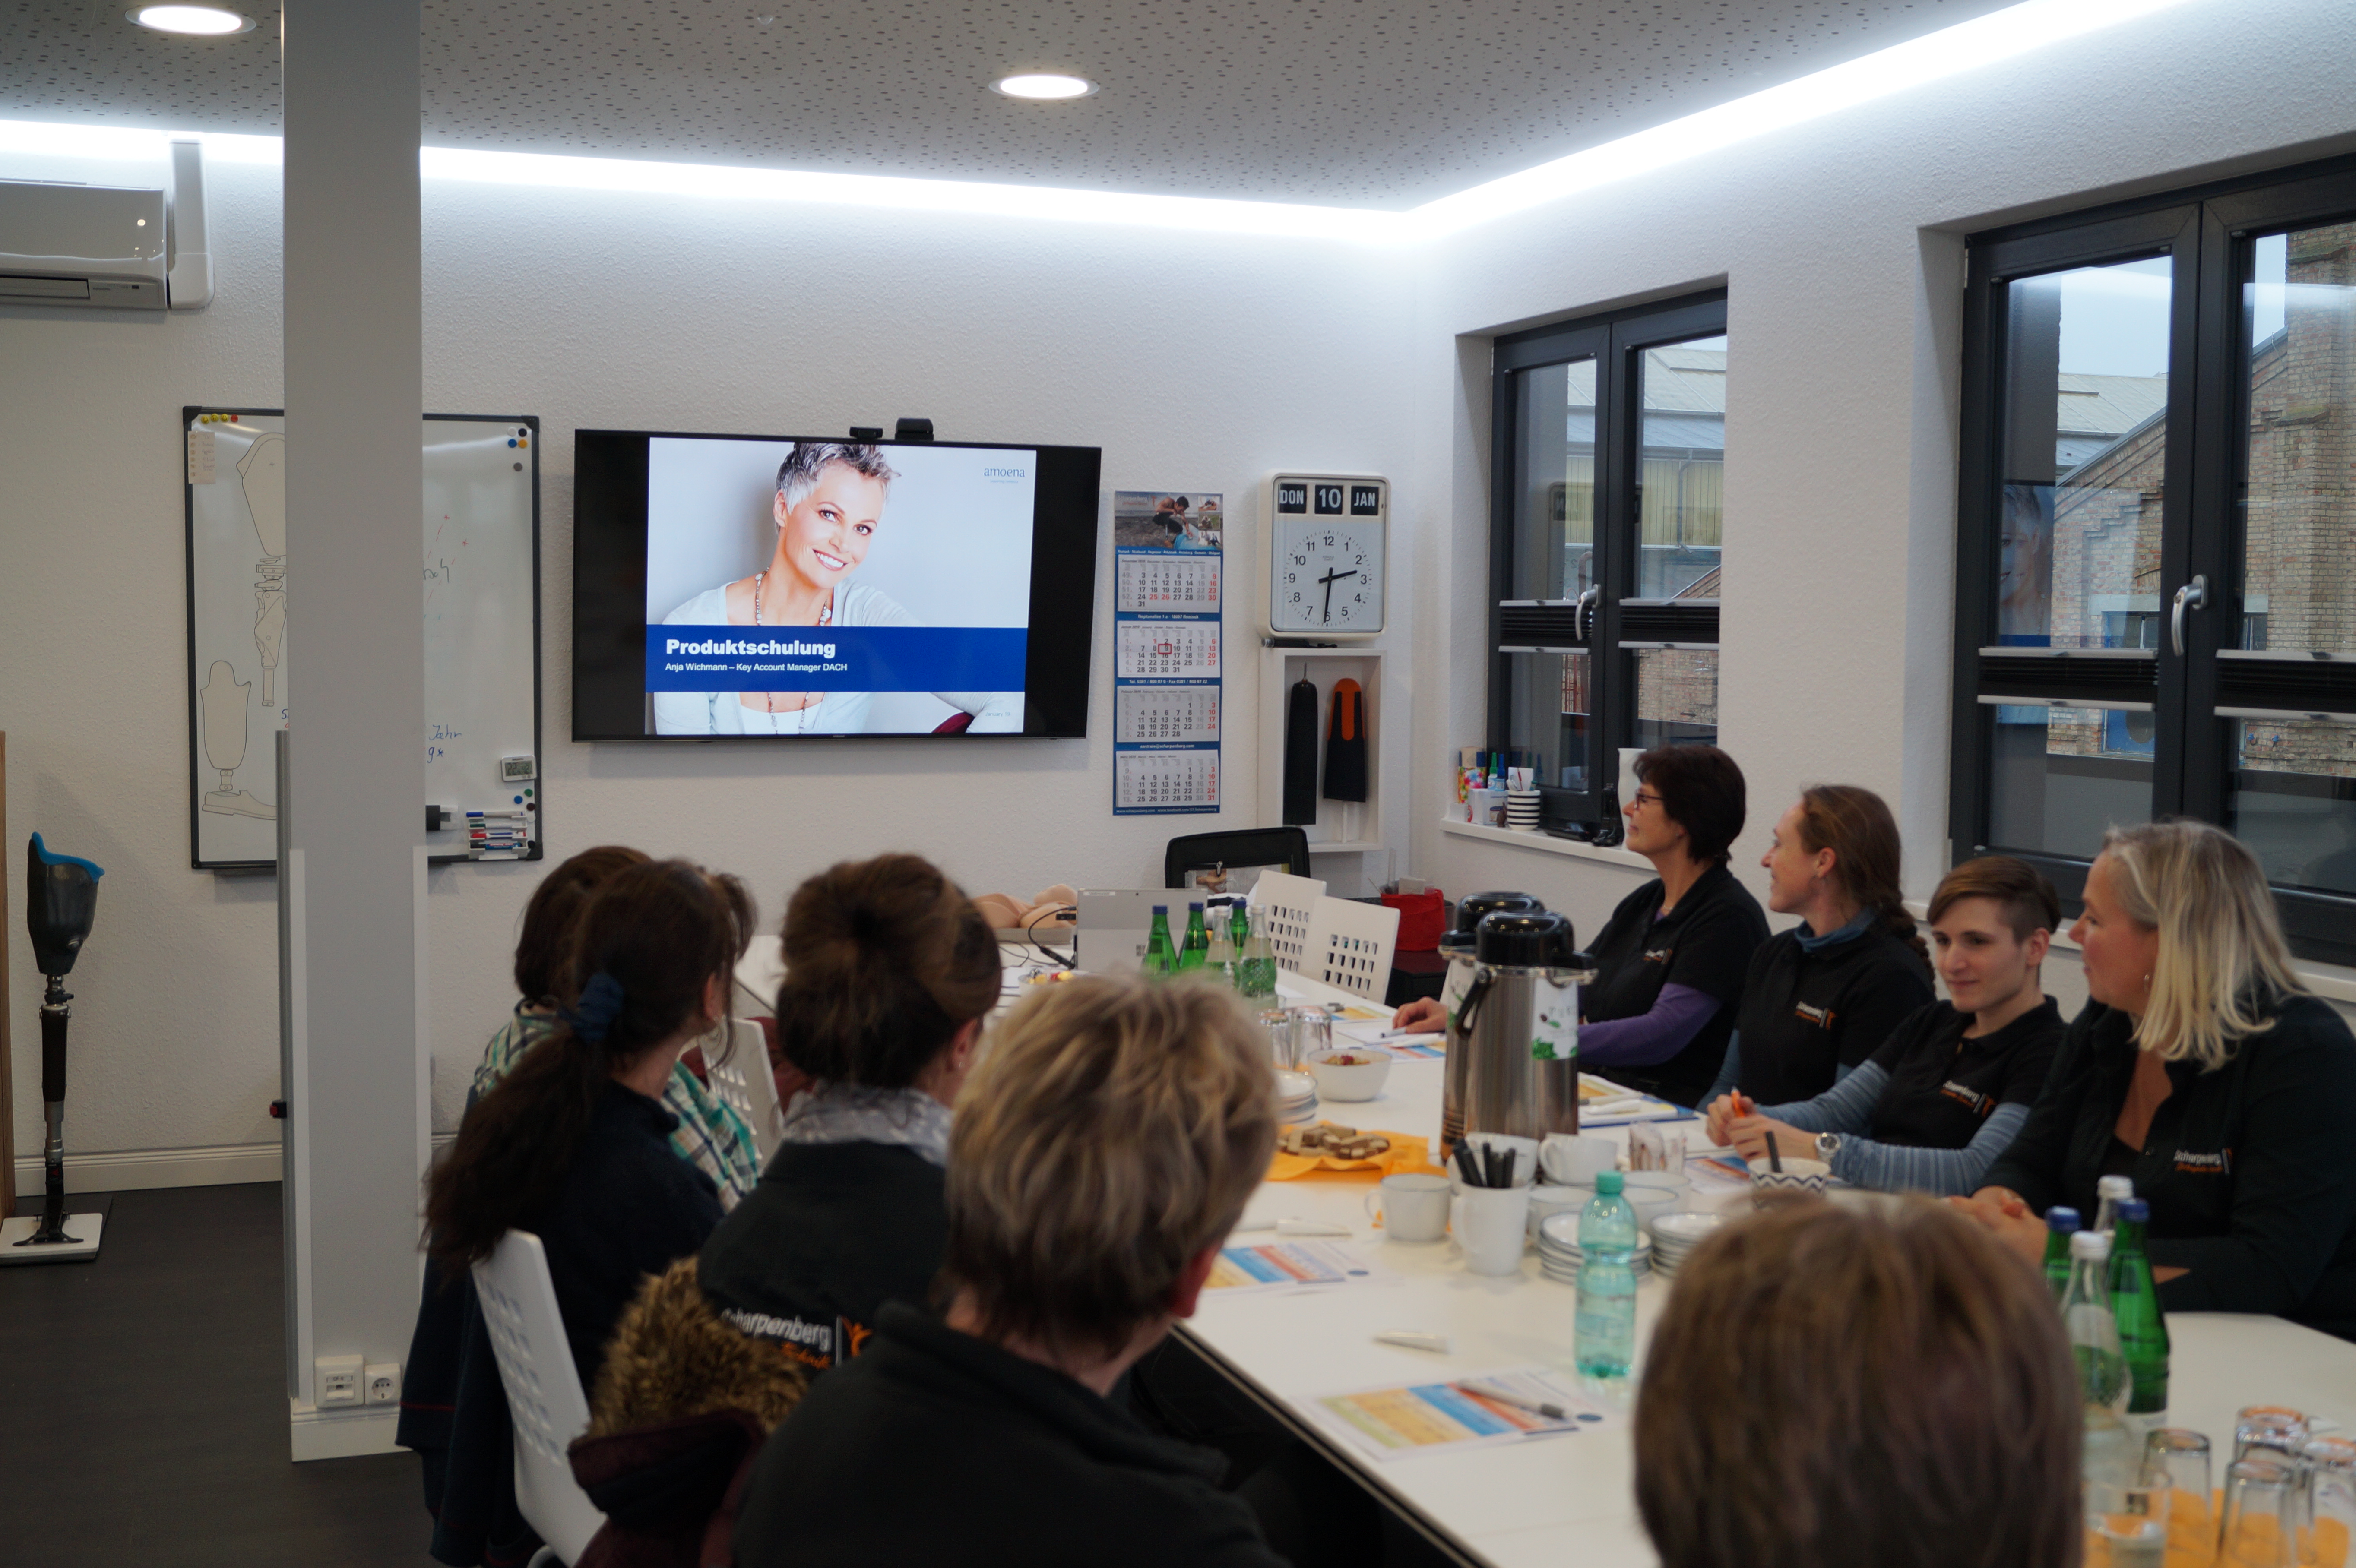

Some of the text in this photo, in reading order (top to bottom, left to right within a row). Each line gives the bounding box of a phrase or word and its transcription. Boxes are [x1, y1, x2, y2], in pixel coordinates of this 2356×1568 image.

[984, 468, 1025, 477] amoena
[1279, 489, 1376, 508] DON 10 JAN
[1323, 536, 1334, 546] 12
[1306, 542, 1315, 551] 11
[1345, 542, 1349, 551] 1
[1294, 555, 1306, 566] 10
[1355, 555, 1362, 564] 2
[1289, 573, 1296, 583] 9
[1361, 575, 1367, 584] 3
[1294, 592, 1300, 602] 8
[1355, 594, 1361, 603] 4
[1307, 606, 1313, 616] 7
[1342, 607, 1348, 616] 5
[1324, 612, 1331, 622] 6
[666, 639, 836, 658] Produktschulung
[665, 663, 684, 672] Anja
[737, 663, 751, 673] Key
[787, 664, 821, 673] Manager
